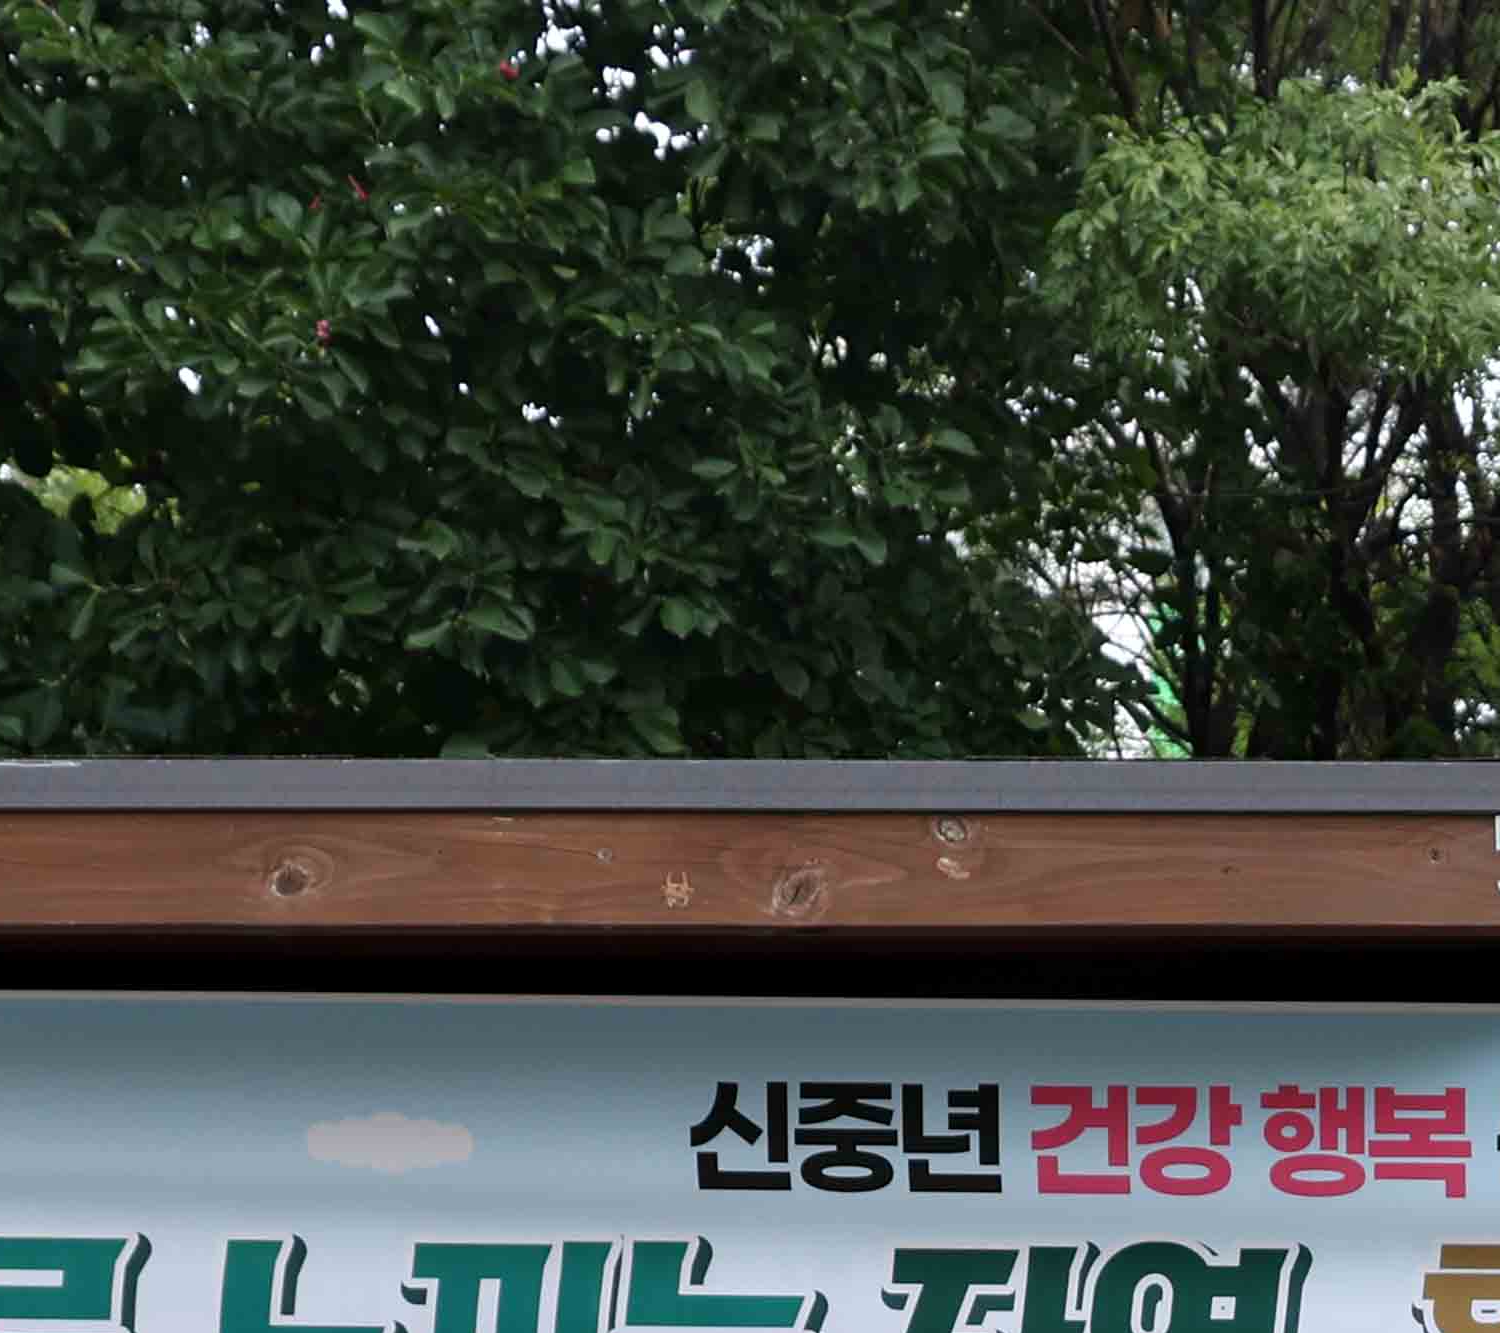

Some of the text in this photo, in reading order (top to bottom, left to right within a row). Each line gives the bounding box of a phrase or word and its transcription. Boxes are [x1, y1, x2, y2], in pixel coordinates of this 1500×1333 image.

[689, 1080, 1003, 1194] 신중년
[1029, 1084, 1243, 1197] 건강
[1259, 1084, 1473, 1199] 행복
